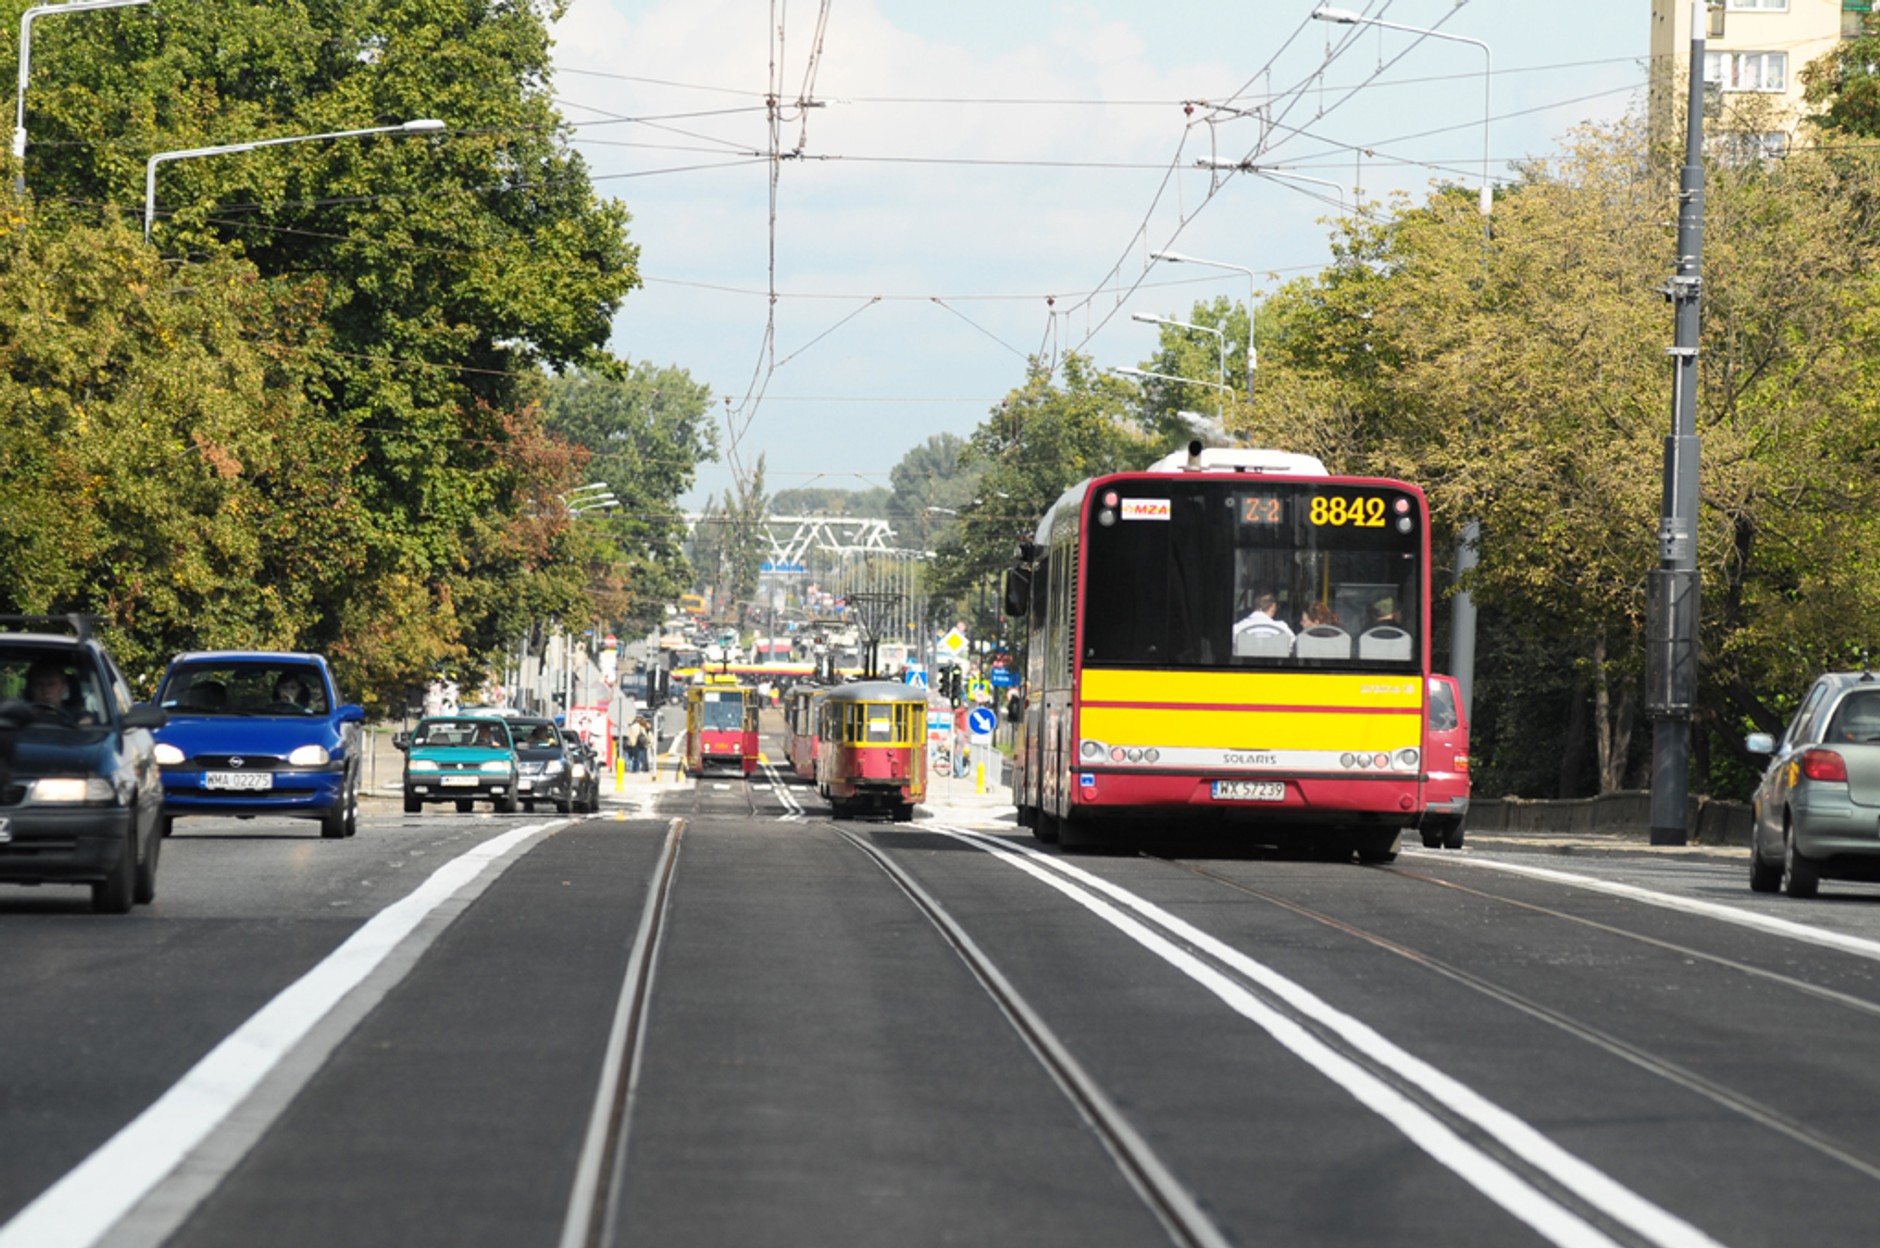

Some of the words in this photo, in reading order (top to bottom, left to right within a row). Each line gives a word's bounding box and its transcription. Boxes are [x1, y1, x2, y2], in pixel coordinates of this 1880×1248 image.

[1134, 505, 1168, 515] MZA
[1246, 497, 1281, 523] Z-2
[1309, 496, 1386, 527] 8842
[1223, 754, 1277, 765] SOLARIS
[207, 774, 229, 785] WMA
[233, 774, 270, 787] 02275
[1220, 781, 1239, 795] WX
[1243, 782, 1283, 796] 57239
